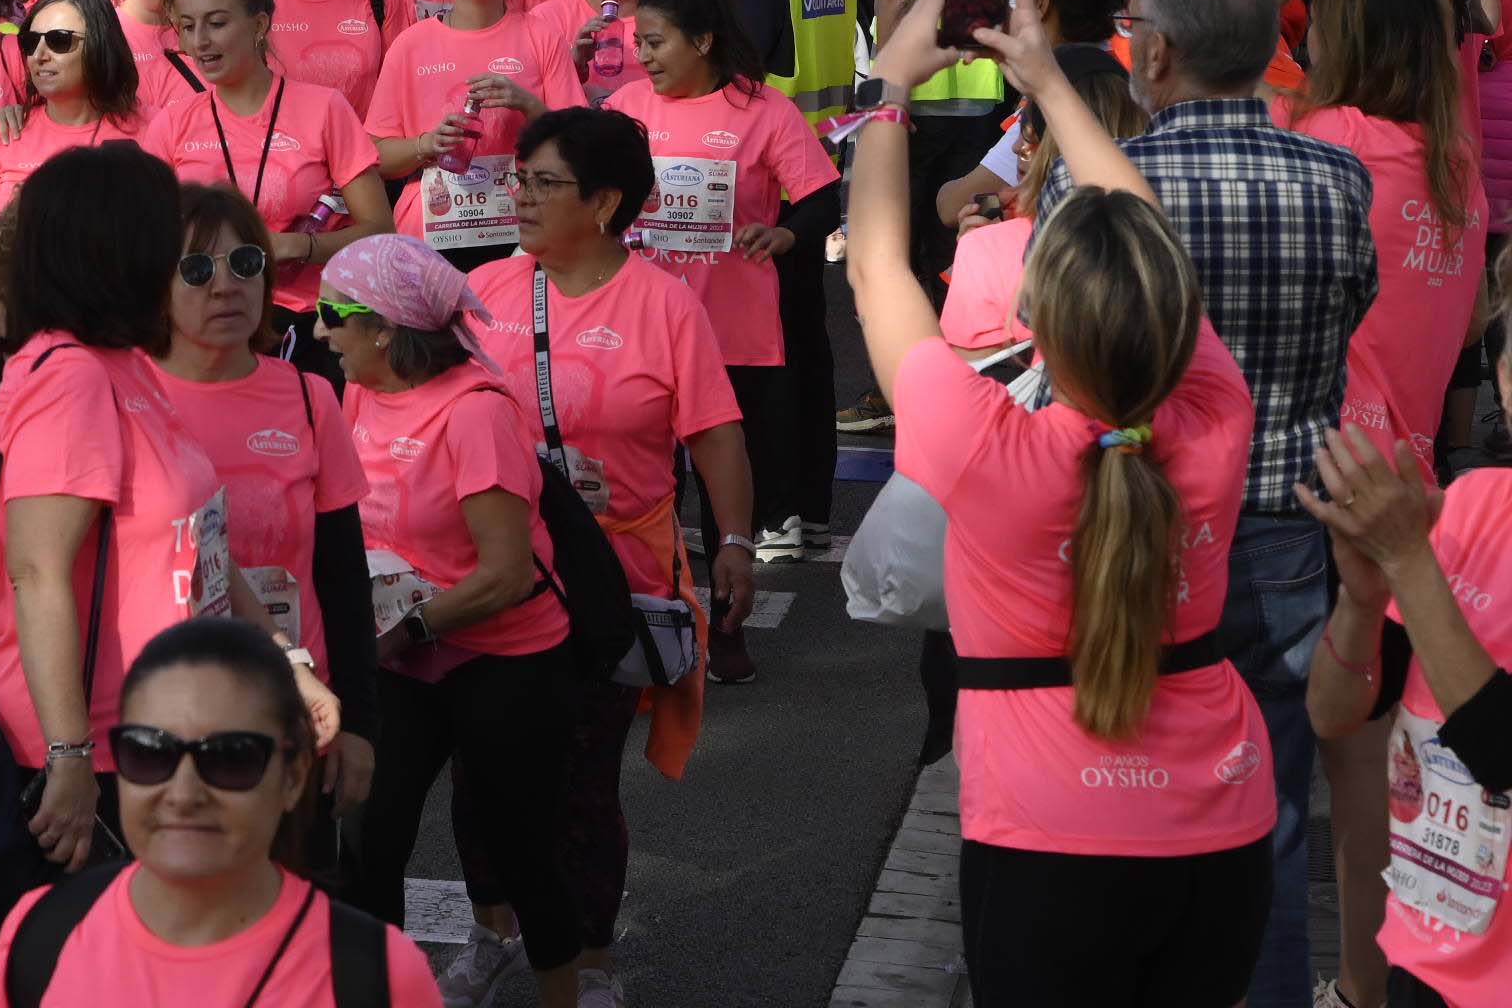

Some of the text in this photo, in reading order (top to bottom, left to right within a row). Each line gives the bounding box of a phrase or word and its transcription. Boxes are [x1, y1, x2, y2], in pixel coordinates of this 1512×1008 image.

[272, 23, 309, 32] OYSHO
[417, 63, 456, 76] OYSHO
[664, 172, 701, 182] ASTURIANA
[454, 192, 487, 207] 016
[663, 193, 699, 208] 016
[458, 208, 484, 218] 30904
[666, 210, 694, 220] 30902
[434, 222, 462, 230] CARRERA
[643, 221, 668, 229] CARRERA
[433, 234, 462, 244] OYSHO
[693, 236, 726, 245] Santander
[1081, 767, 1170, 788] OYSHO
[1428, 792, 1470, 832] 016
[1422, 827, 1460, 857] 31878
